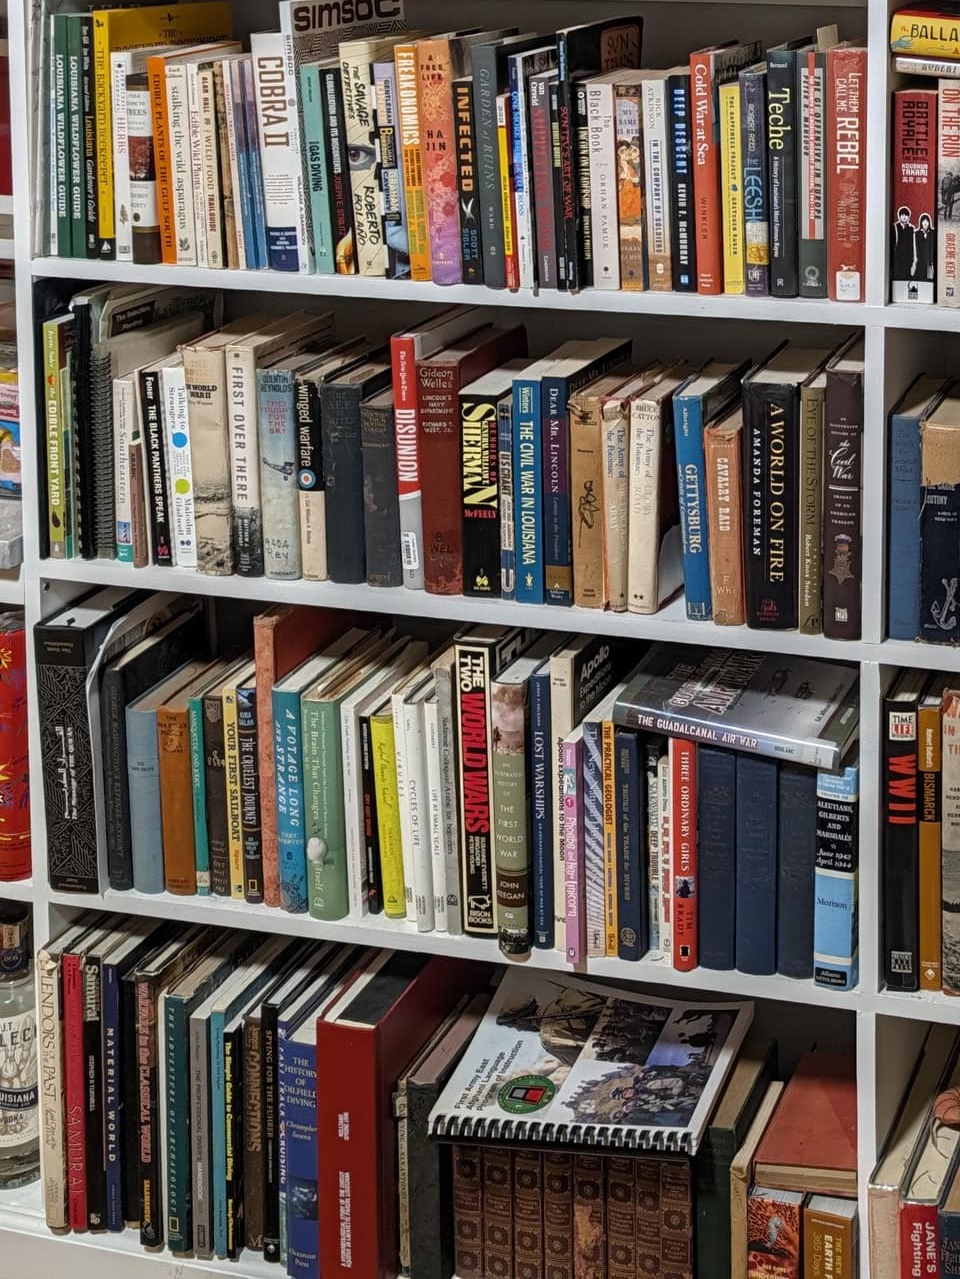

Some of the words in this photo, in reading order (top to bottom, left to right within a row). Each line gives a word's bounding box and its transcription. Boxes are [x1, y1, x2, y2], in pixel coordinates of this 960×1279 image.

[257, 56, 289, 127] COBRA
[397, 51, 420, 146] FREAKONOMICS
[942, 88, 960, 104] ON
[264, 131, 290, 147] II
[456, 86, 474, 191] INFECTED
[768, 88, 792, 151] Teche
[836, 115, 859, 174] REBEL
[942, 108, 960, 132] THE
[942, 136, 960, 159] RUN
[232, 367, 244, 411] FIRST
[770, 404, 785, 419] A
[232, 416, 246, 449] OVER
[396, 409, 419, 482] DISUNION
[462, 403, 498, 509] SHERMAN
[769, 421, 785, 496] WORLD
[235, 455, 248, 501] THERE
[684, 463, 701, 554] GETTYSBURG
[770, 501, 785, 527] ON
[769, 537, 784, 583] FIRE
[460, 654, 473, 692] TWO
[470, 656, 485, 692] THE
[460, 692, 487, 773] WORLD
[638, 714, 654, 726] THE
[657, 718, 717, 741] GUADALCANAL
[722, 731, 737, 743] AIR
[739, 735, 757, 748] WAR
[464, 772, 489, 834] WARS
[924, 773, 937, 821] BISMARCK
[69, 1106, 82, 1195] SAMURAI
[108, 1110, 116, 1162] WORLD
[911, 1222, 923, 1277] Fighting
[925, 1222, 935, 1274] JANE'S
